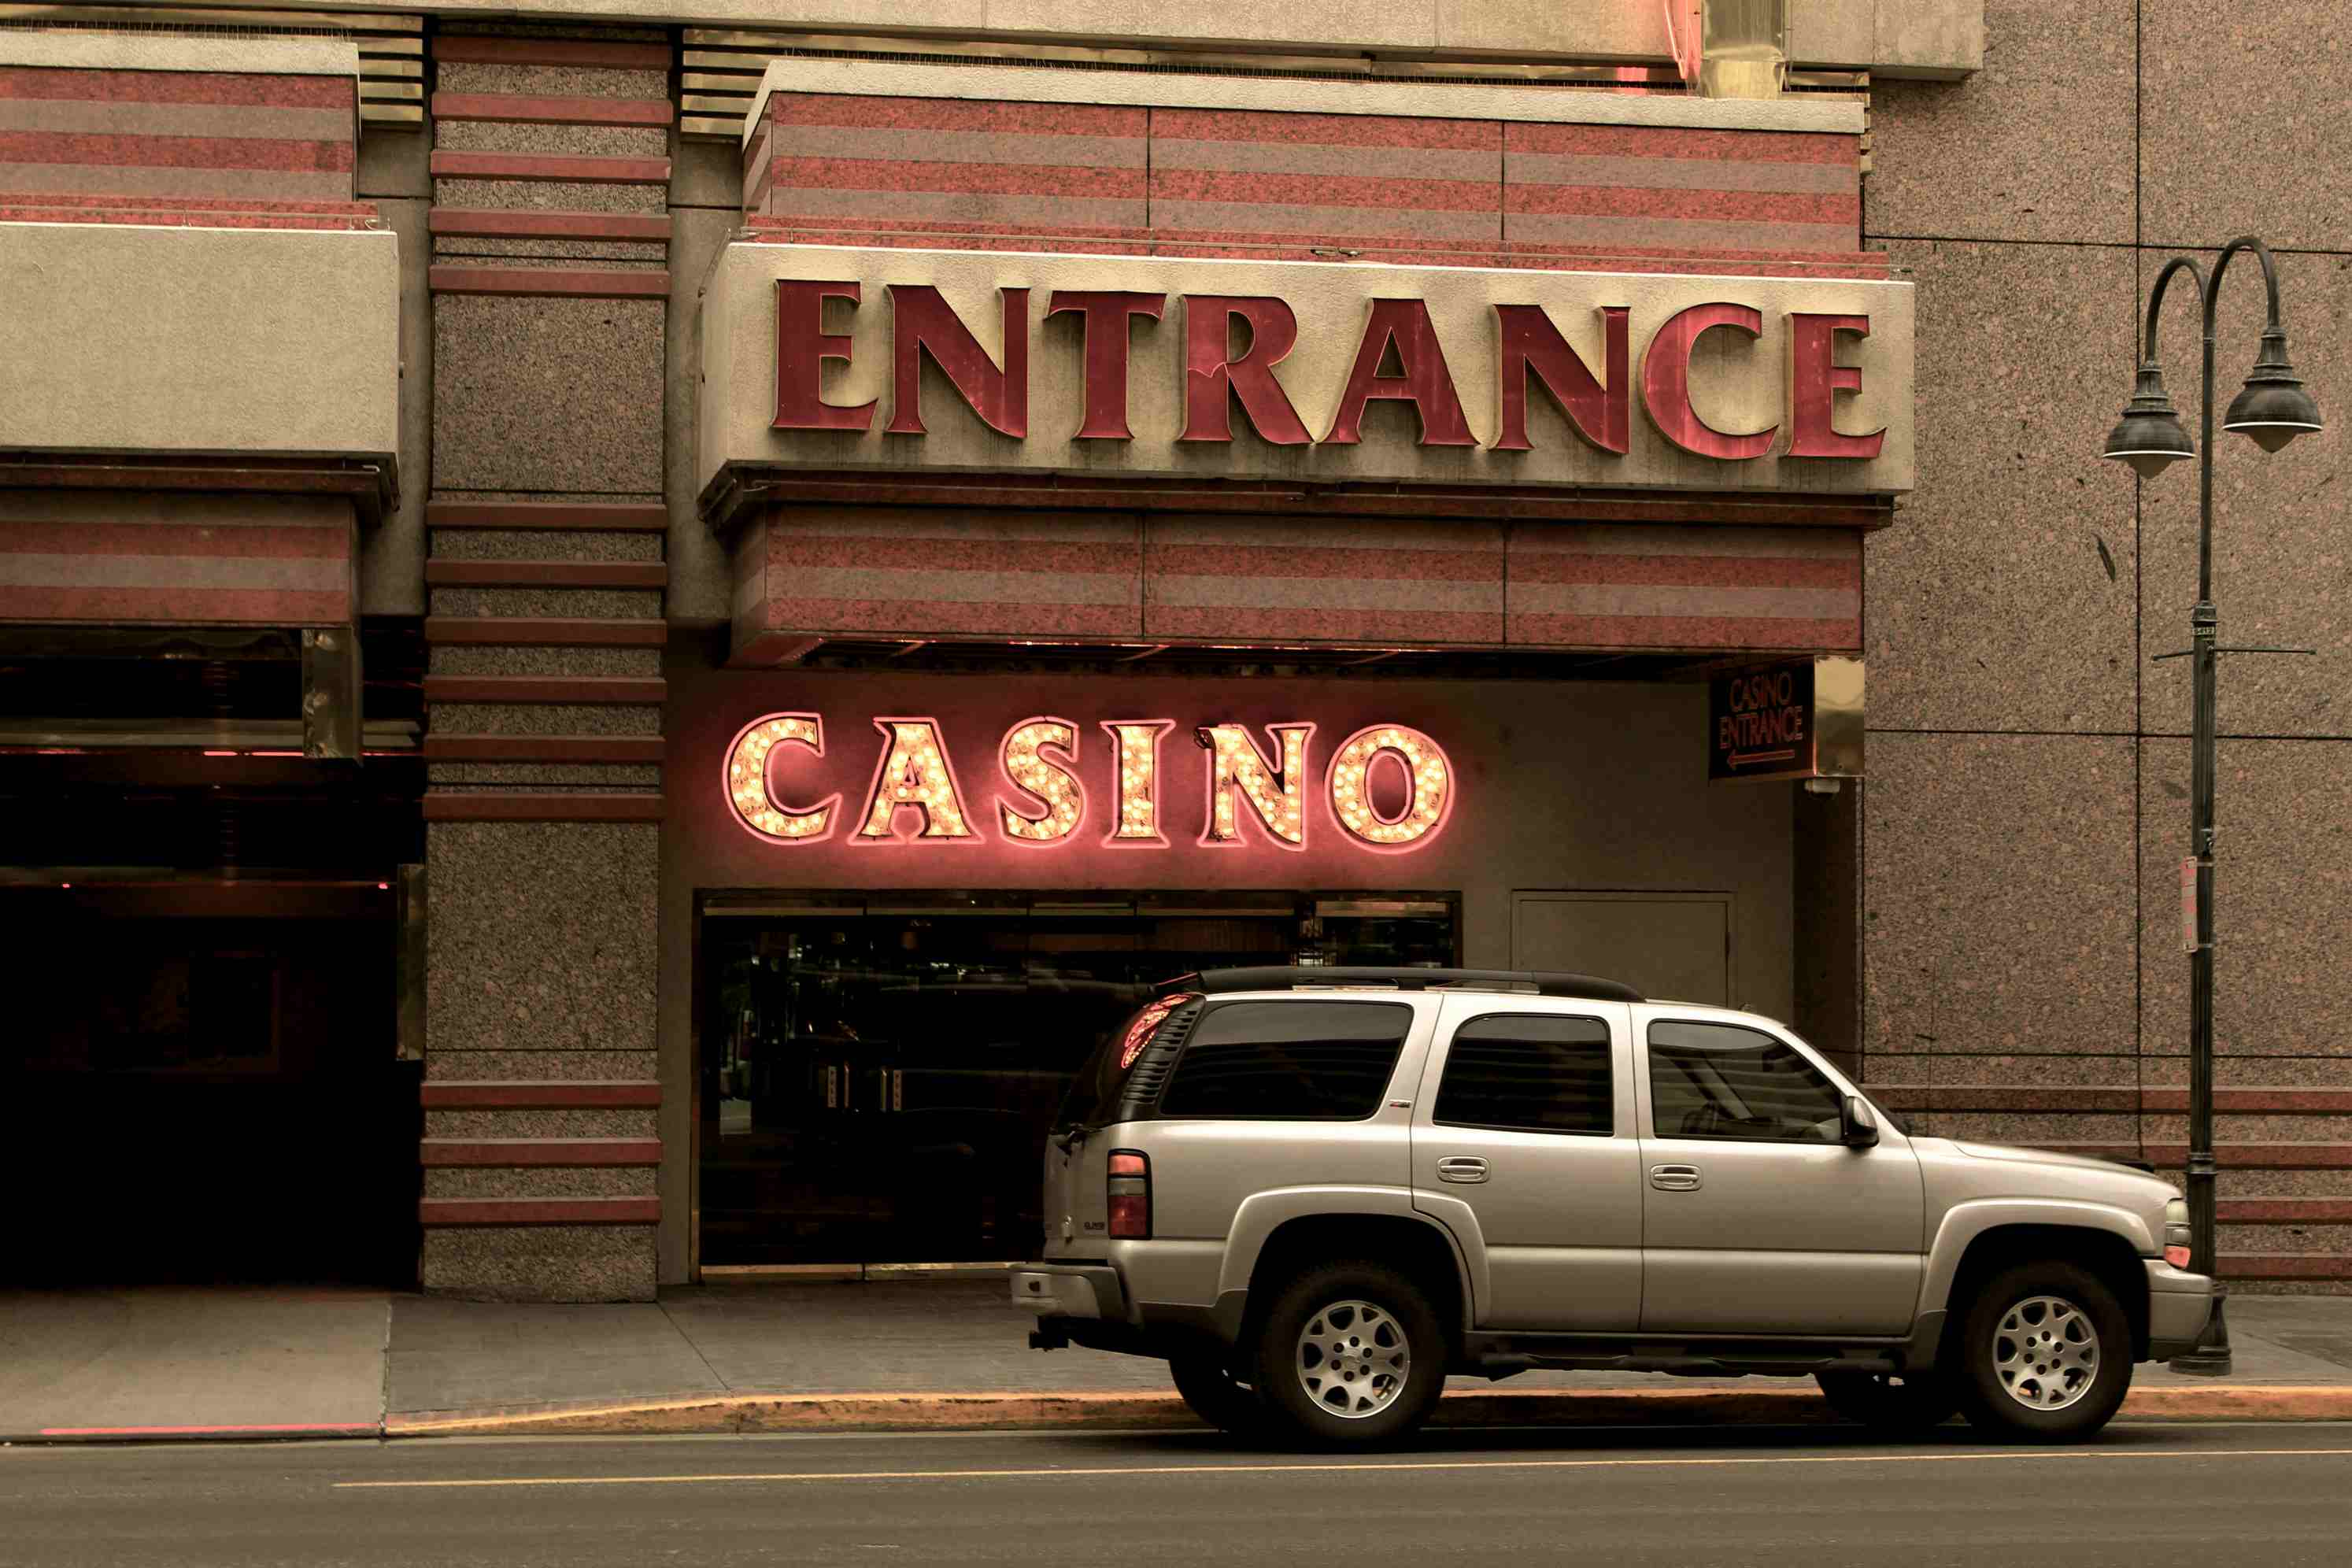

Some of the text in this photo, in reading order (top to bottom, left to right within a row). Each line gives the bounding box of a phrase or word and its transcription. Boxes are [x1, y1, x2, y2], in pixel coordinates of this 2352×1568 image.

[771, 279, 1887, 460] ENTRANCE
[1719, 705, 1803, 749] ENTRANCE
[1729, 671, 1792, 712] CASINO
[723, 712, 1455, 854] CASINO
